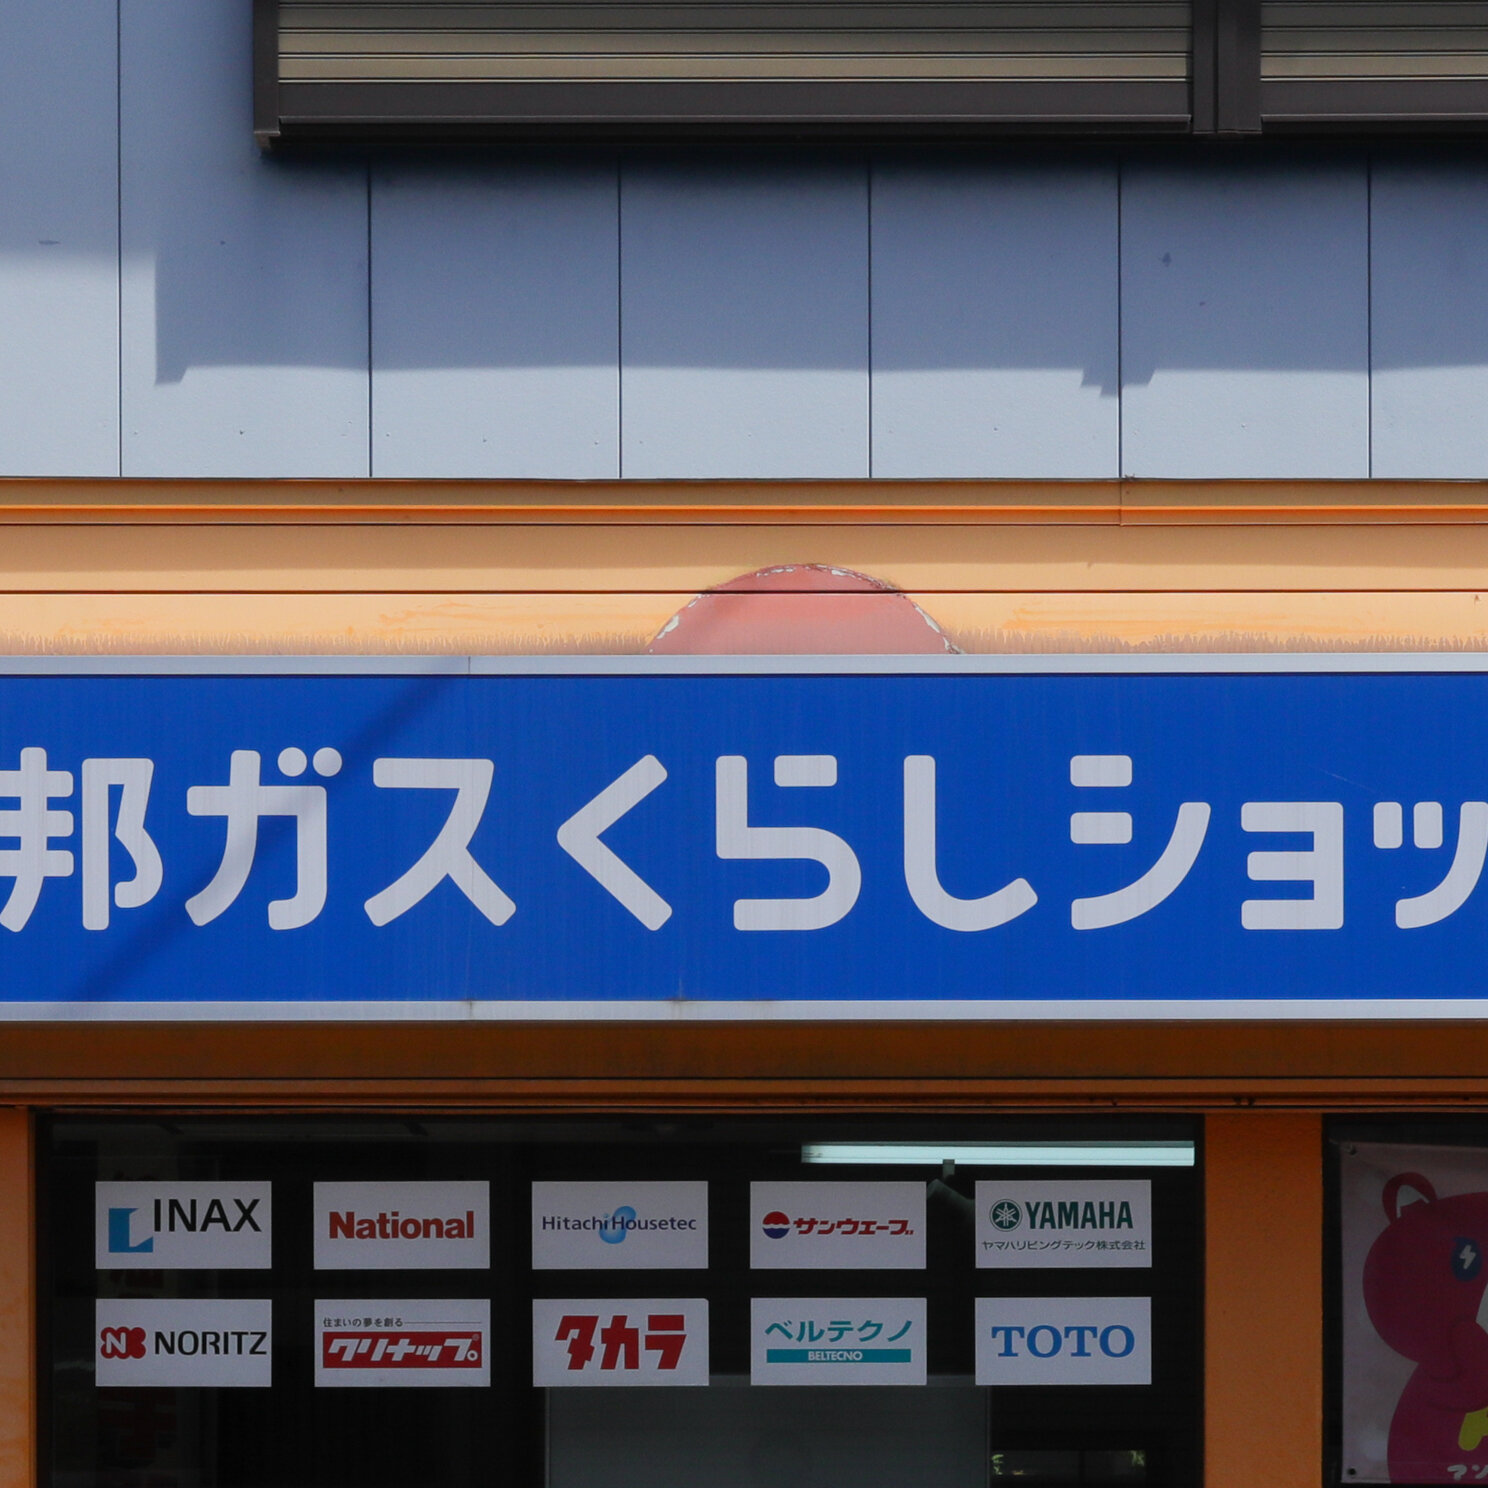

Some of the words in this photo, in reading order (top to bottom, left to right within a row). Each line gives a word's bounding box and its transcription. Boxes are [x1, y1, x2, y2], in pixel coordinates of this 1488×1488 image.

[153, 1199, 261, 1232] INAX
[329, 1211, 473, 1239] National
[542, 1214, 608, 1232] Hitachi
[612, 1214, 697, 1232] Housetec
[1026, 1201, 1133, 1229] YAMAHA
[982, 1239, 1146, 1251] ヤマハリビングテック株式会社
[323, 1316, 403, 1328] 住まいの夢を創る
[765, 1320, 912, 1343] ベルテクノ
[155, 1331, 267, 1355] NORITZ
[326, 1337, 479, 1362] クリナップ
[555, 1315, 686, 1370] タカラ
[992, 1325, 1135, 1358] TOTO
[808, 1350, 863, 1361] BELTECNO
